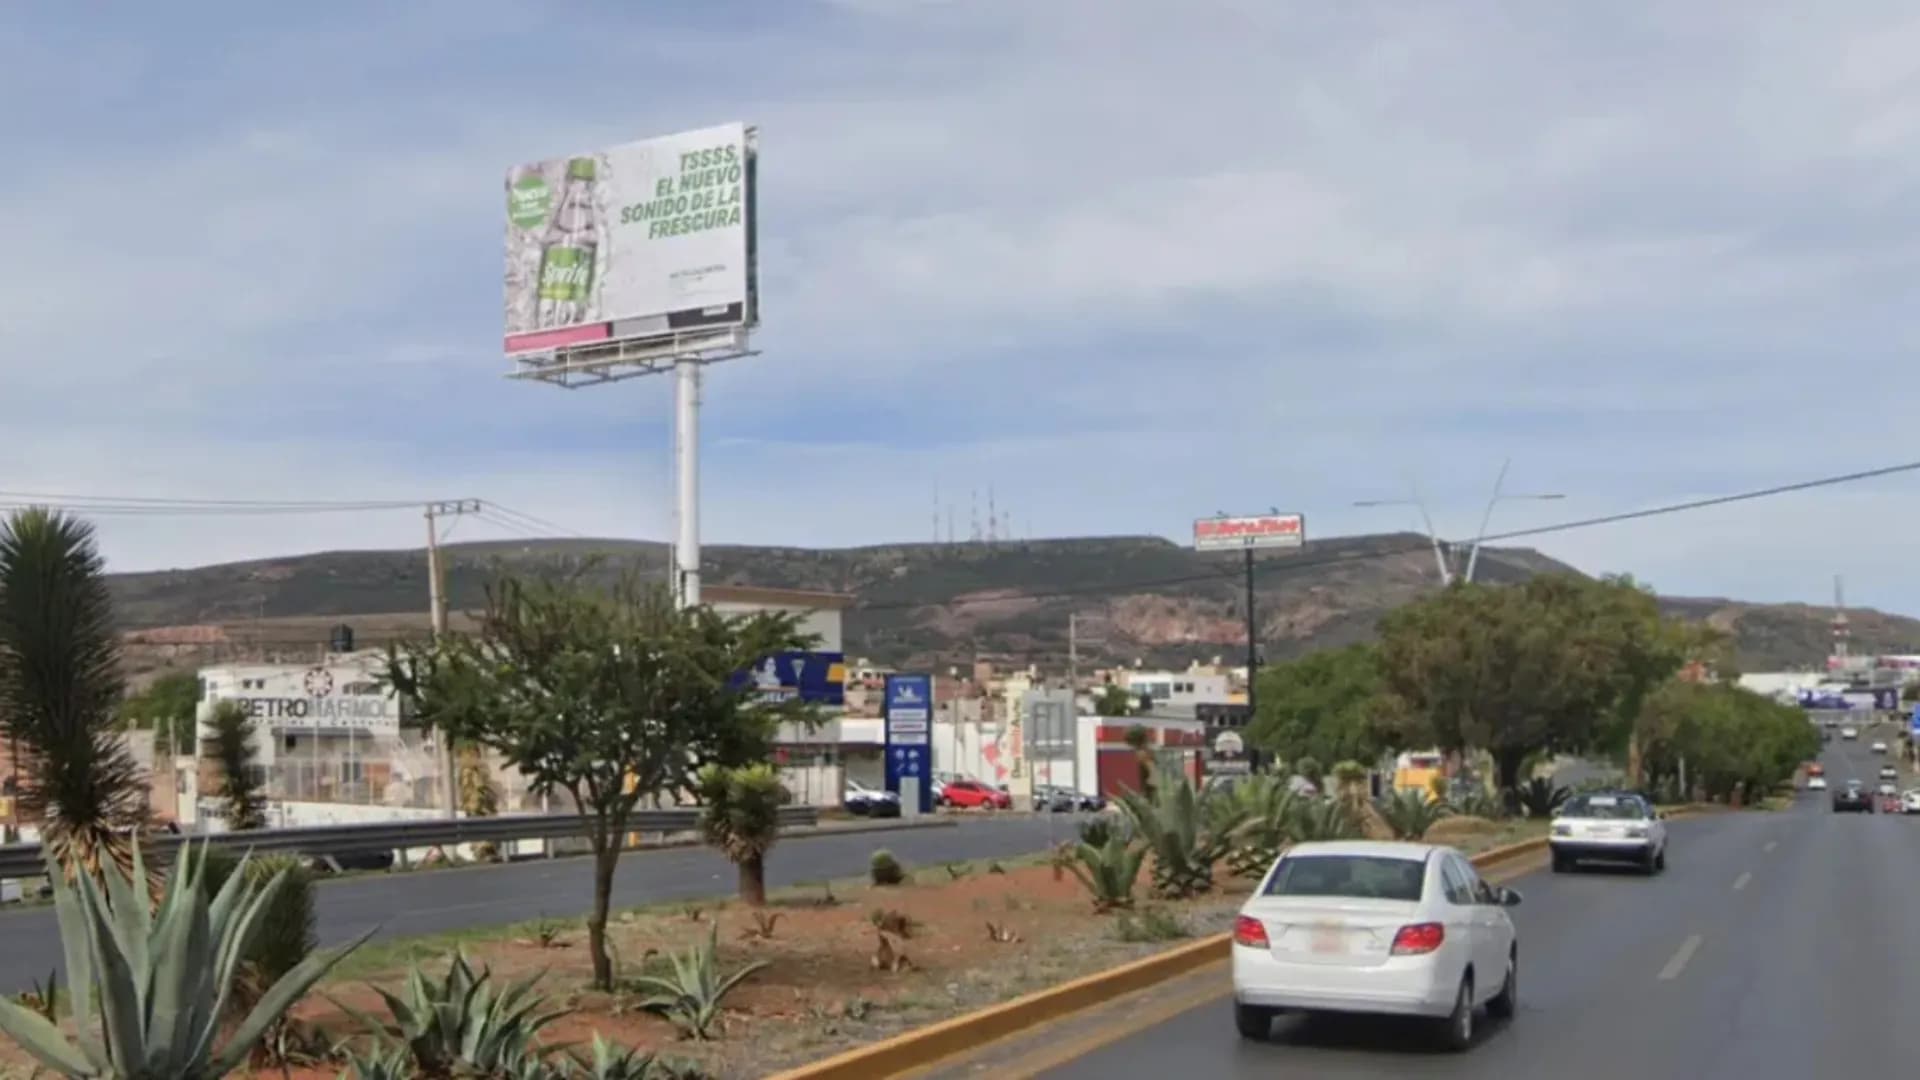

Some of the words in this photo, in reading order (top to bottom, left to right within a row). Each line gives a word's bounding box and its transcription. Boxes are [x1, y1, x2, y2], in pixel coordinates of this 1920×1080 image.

[656, 176, 674, 197] EL
[679, 164, 740, 192] NUEVO
[620, 195, 688, 224] SONIDO
[691, 188, 715, 211] DE
[717, 185, 740, 206] LA
[648, 205, 740, 240] FRESCURA
